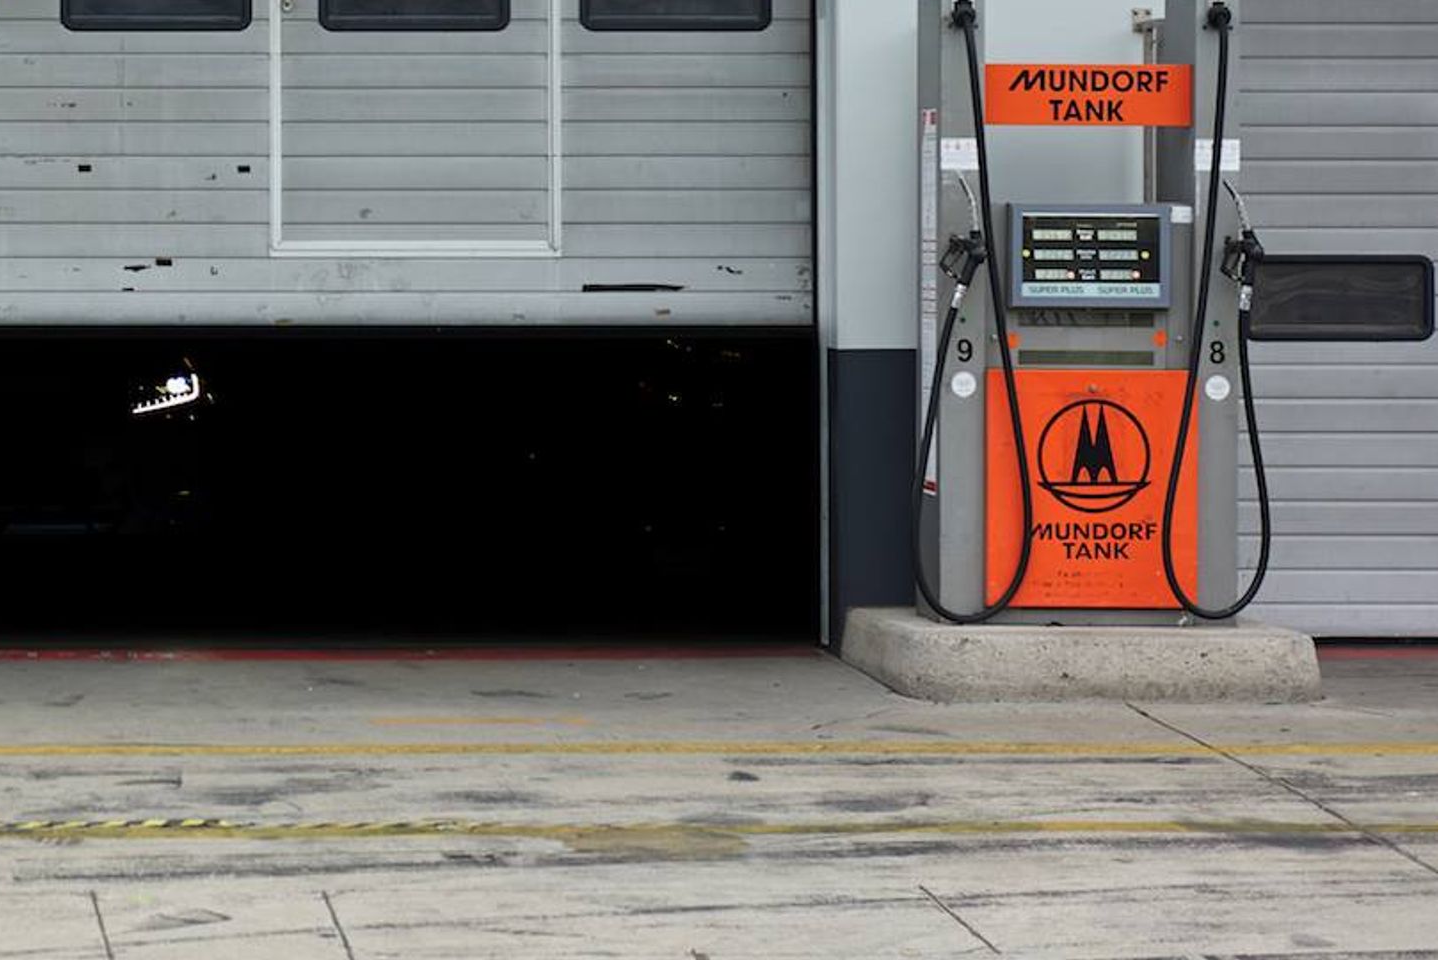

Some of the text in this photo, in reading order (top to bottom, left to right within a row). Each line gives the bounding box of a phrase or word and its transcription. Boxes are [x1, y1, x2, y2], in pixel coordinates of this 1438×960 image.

[1009, 70, 1169, 93] MUNDORF
[1048, 99, 1125, 122] TANK
[957, 338, 973, 362] 9
[1210, 340, 1225, 364] 8
[1031, 523, 1158, 541] MUNDORF
[1063, 542, 1129, 560] TANK
